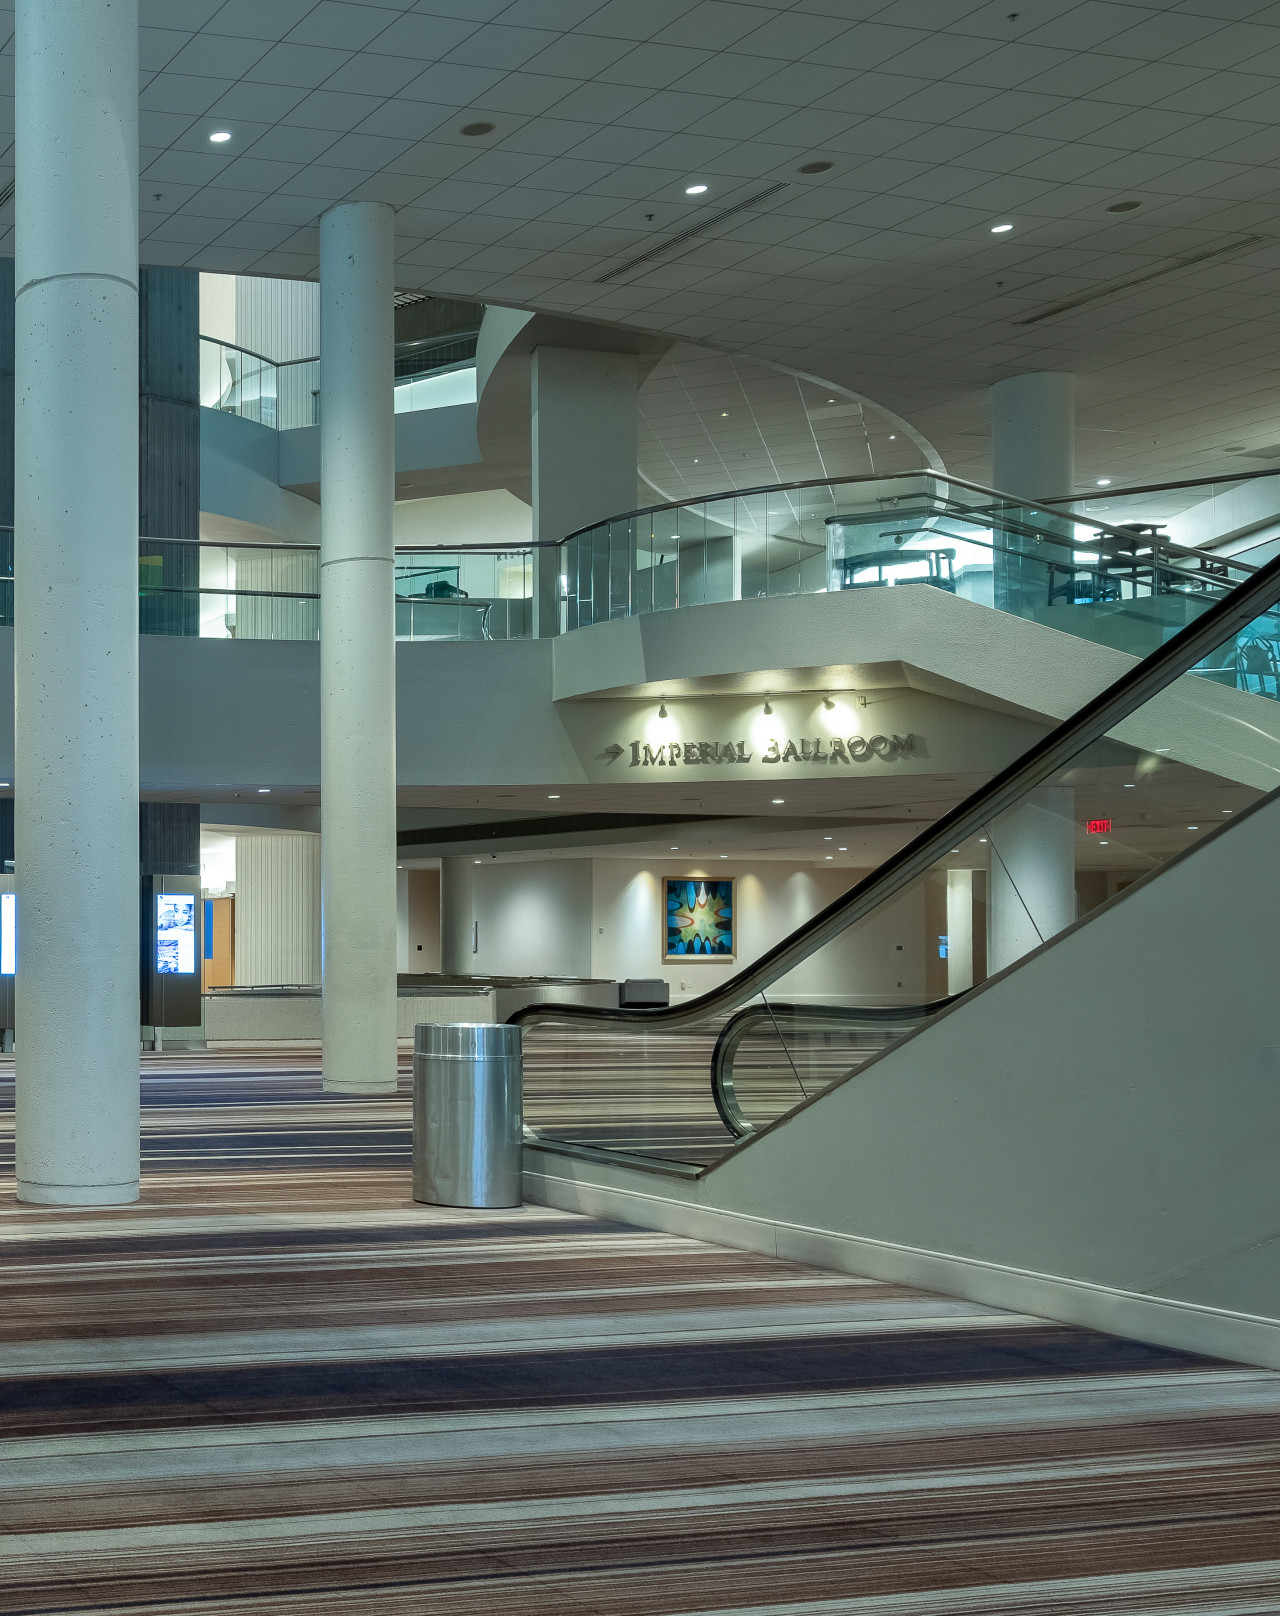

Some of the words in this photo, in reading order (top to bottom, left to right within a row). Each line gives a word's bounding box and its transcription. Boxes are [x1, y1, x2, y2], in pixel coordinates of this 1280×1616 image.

[629, 740, 753, 764] IMPERIAL
[763, 734, 914, 763] BALLROOM
[1091, 820, 1107, 833] EXIT
